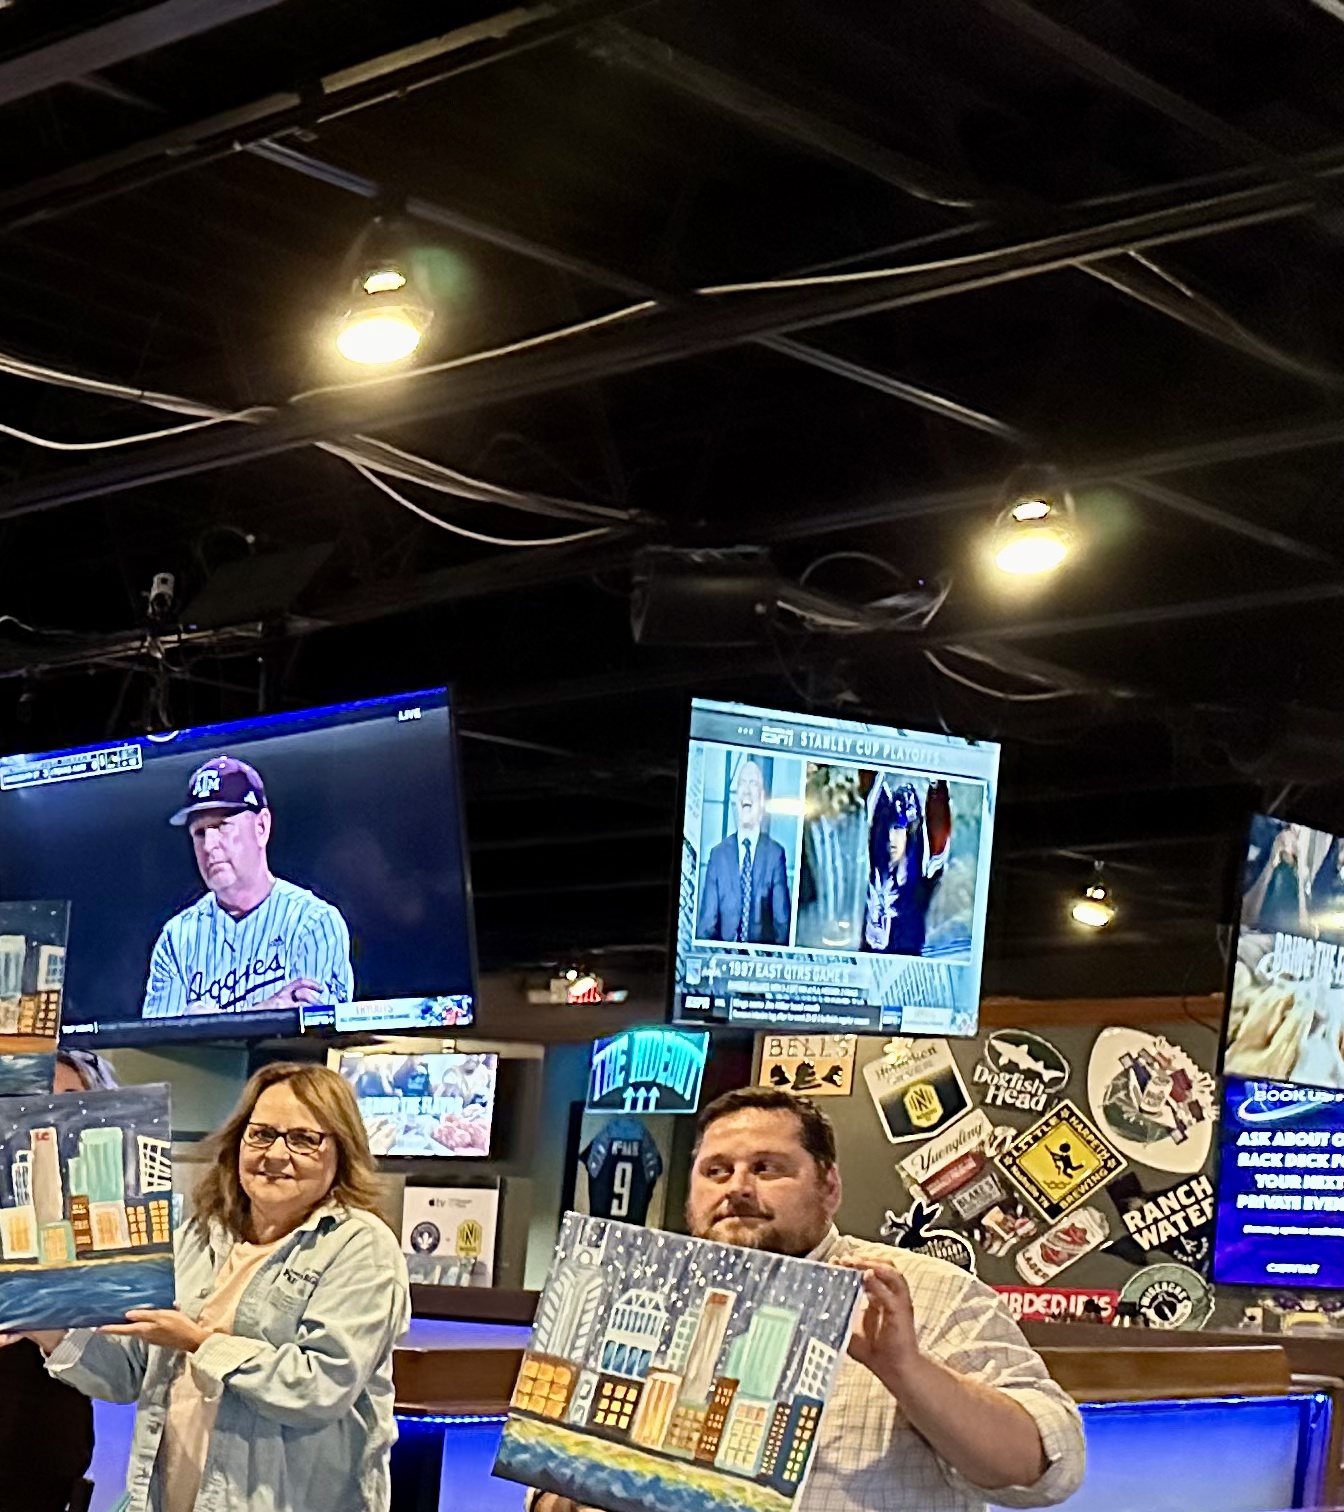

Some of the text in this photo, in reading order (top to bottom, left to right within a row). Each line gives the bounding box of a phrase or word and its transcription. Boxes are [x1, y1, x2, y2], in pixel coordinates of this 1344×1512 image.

[801, 733, 852, 753] STANLEY
[856, 739, 880, 756] CUP
[188, 953, 286, 1004] Aggies
[755, 963, 783, 979] EAST
[593, 1031, 706, 1101] THE HIDEOUT
[973, 1065, 1045, 1096] Dogfish
[985, 1086, 1048, 1112] Head
[1254, 1089, 1306, 1102] BOOK
[912, 1122, 984, 1177] Yuengling
[1069, 1116, 1111, 1161] HARPETH
[610, 1161, 633, 1217] 9
[1059, 1167, 1109, 1210] BREWING
[1122, 1175, 1213, 1233] RANCH
[1303, 1196, 1344, 1211] EVEN
[1022, 1251, 1051, 1282] LAGER
